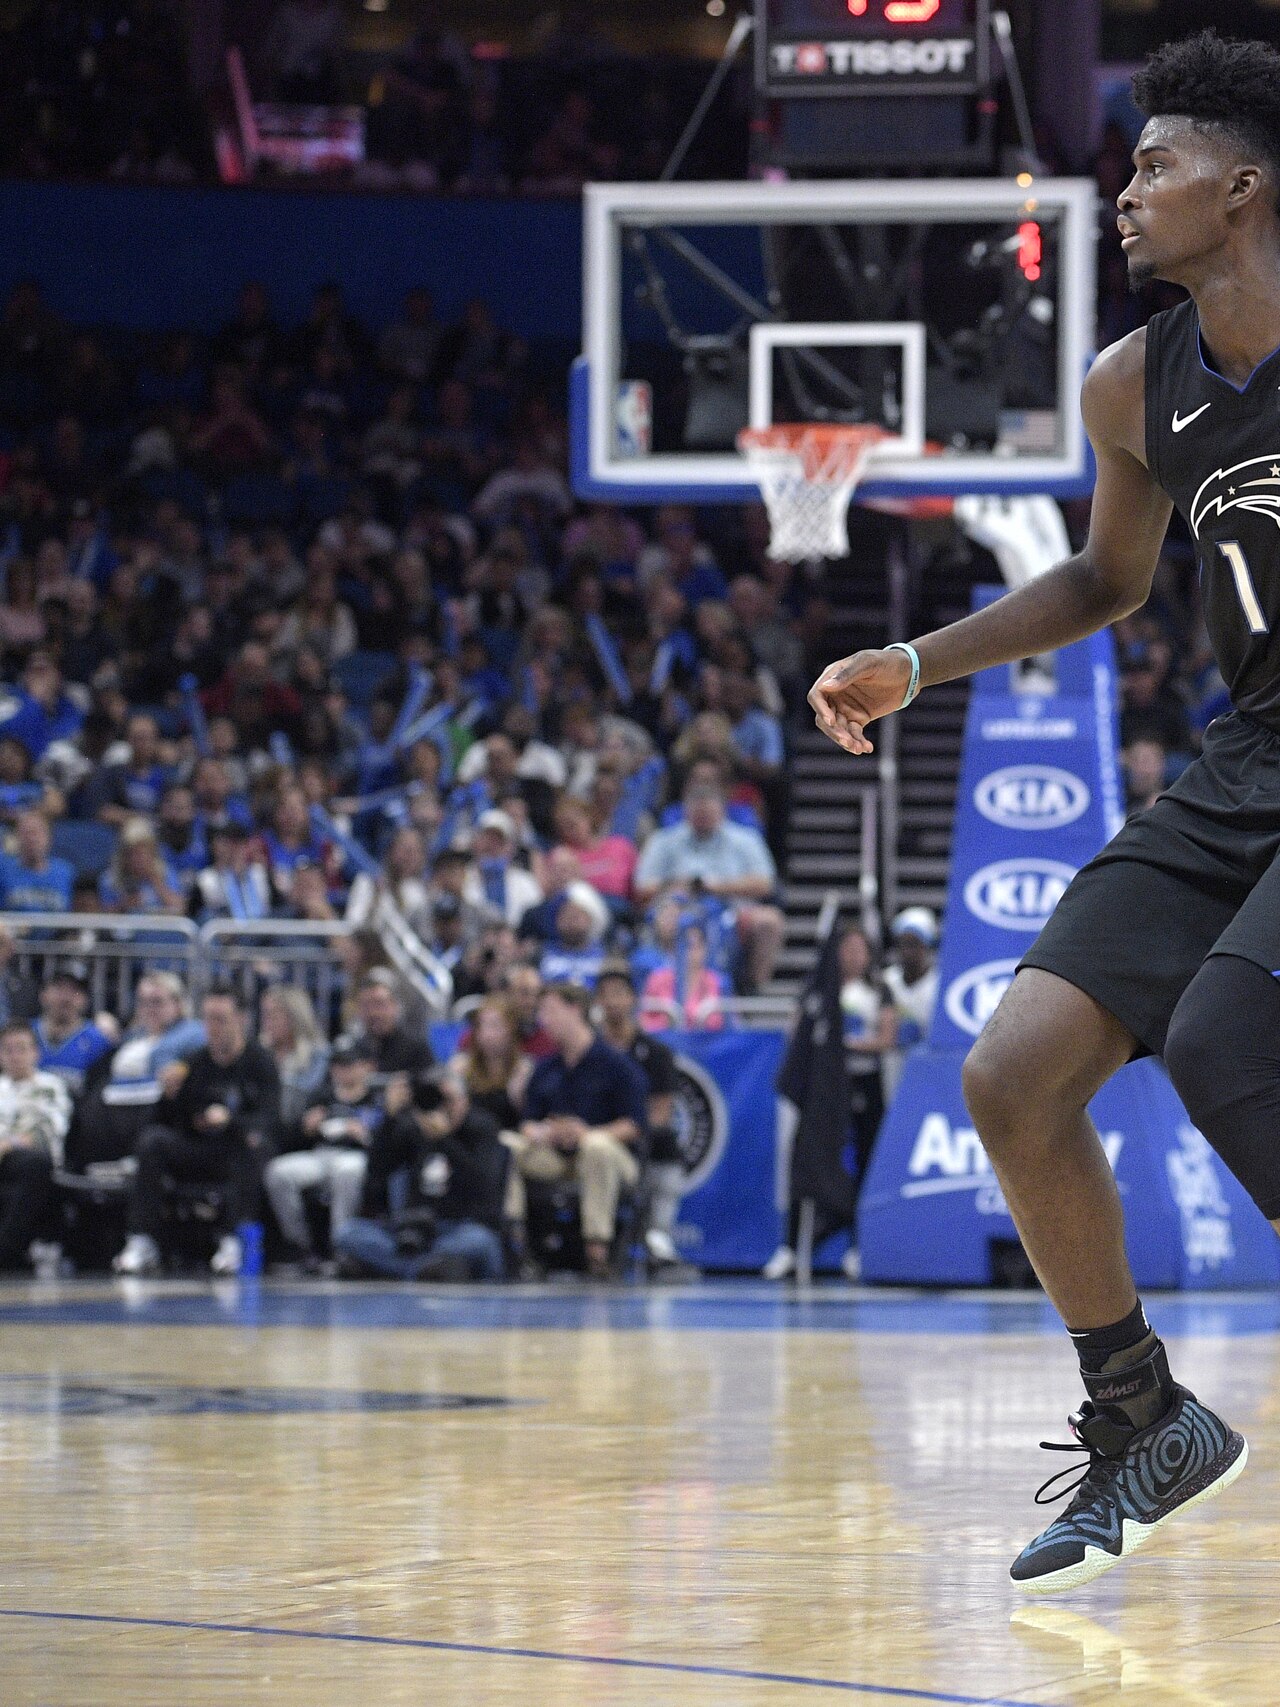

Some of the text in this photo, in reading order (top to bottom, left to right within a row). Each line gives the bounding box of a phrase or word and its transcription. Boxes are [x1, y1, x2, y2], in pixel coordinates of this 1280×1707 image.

[826, 38, 973, 75] TISSOT
[1216, 540, 1270, 635] 1
[994, 780, 1067, 813] KIA
